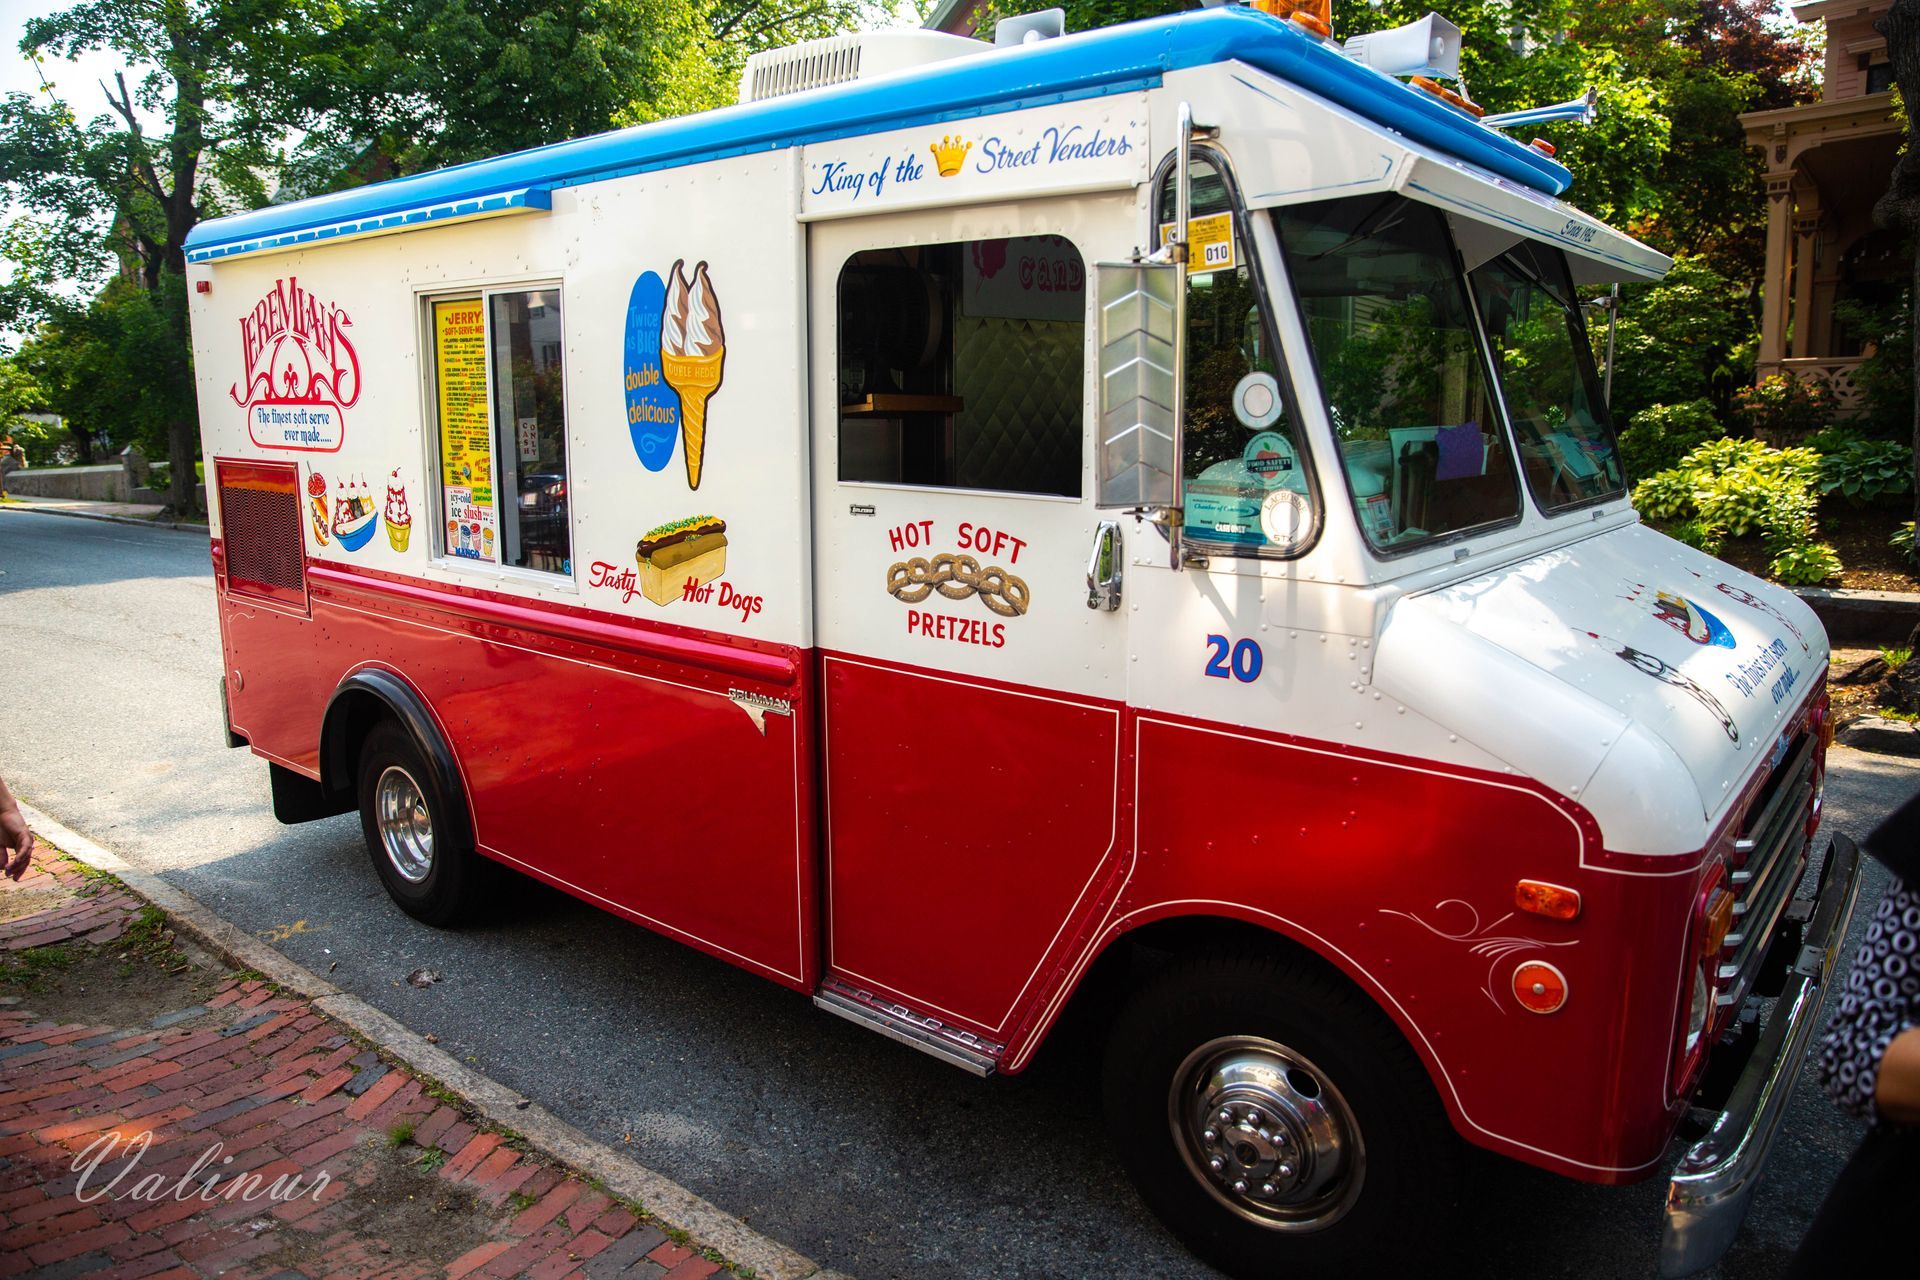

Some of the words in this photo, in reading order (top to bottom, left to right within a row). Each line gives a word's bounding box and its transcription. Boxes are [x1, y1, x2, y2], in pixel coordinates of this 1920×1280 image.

[868, 156, 891, 197] of
[895, 153, 924, 183] the
[976, 137, 1042, 174] Street
[1206, 245, 1227, 262] 010
[630, 305, 658, 329] Twice
[625, 362, 660, 391] double
[257, 407, 270, 427] The
[271, 408, 292, 427] finest
[293, 408, 308, 425] soft
[309, 412, 330, 425] serve
[629, 397, 675, 424] delicious
[284, 429, 299, 441] ever
[522, 422, 530, 455] CASH
[1266, 458, 1291, 466] SAFETY
[464, 504, 482, 521] slush
[1215, 524, 1230, 532] CASH
[1273, 534, 1294, 544] STX
[455, 547, 480, 559] MANGO
[888, 520, 934, 552] HOT
[957, 522, 1027, 564] SOFT
[589, 561, 642, 604] Tasty
[683, 576, 714, 604] Hot
[718, 581, 763, 623] Dogs
[908, 609, 1006, 648] PRETZELS
[1205, 633, 1264, 683] 20
